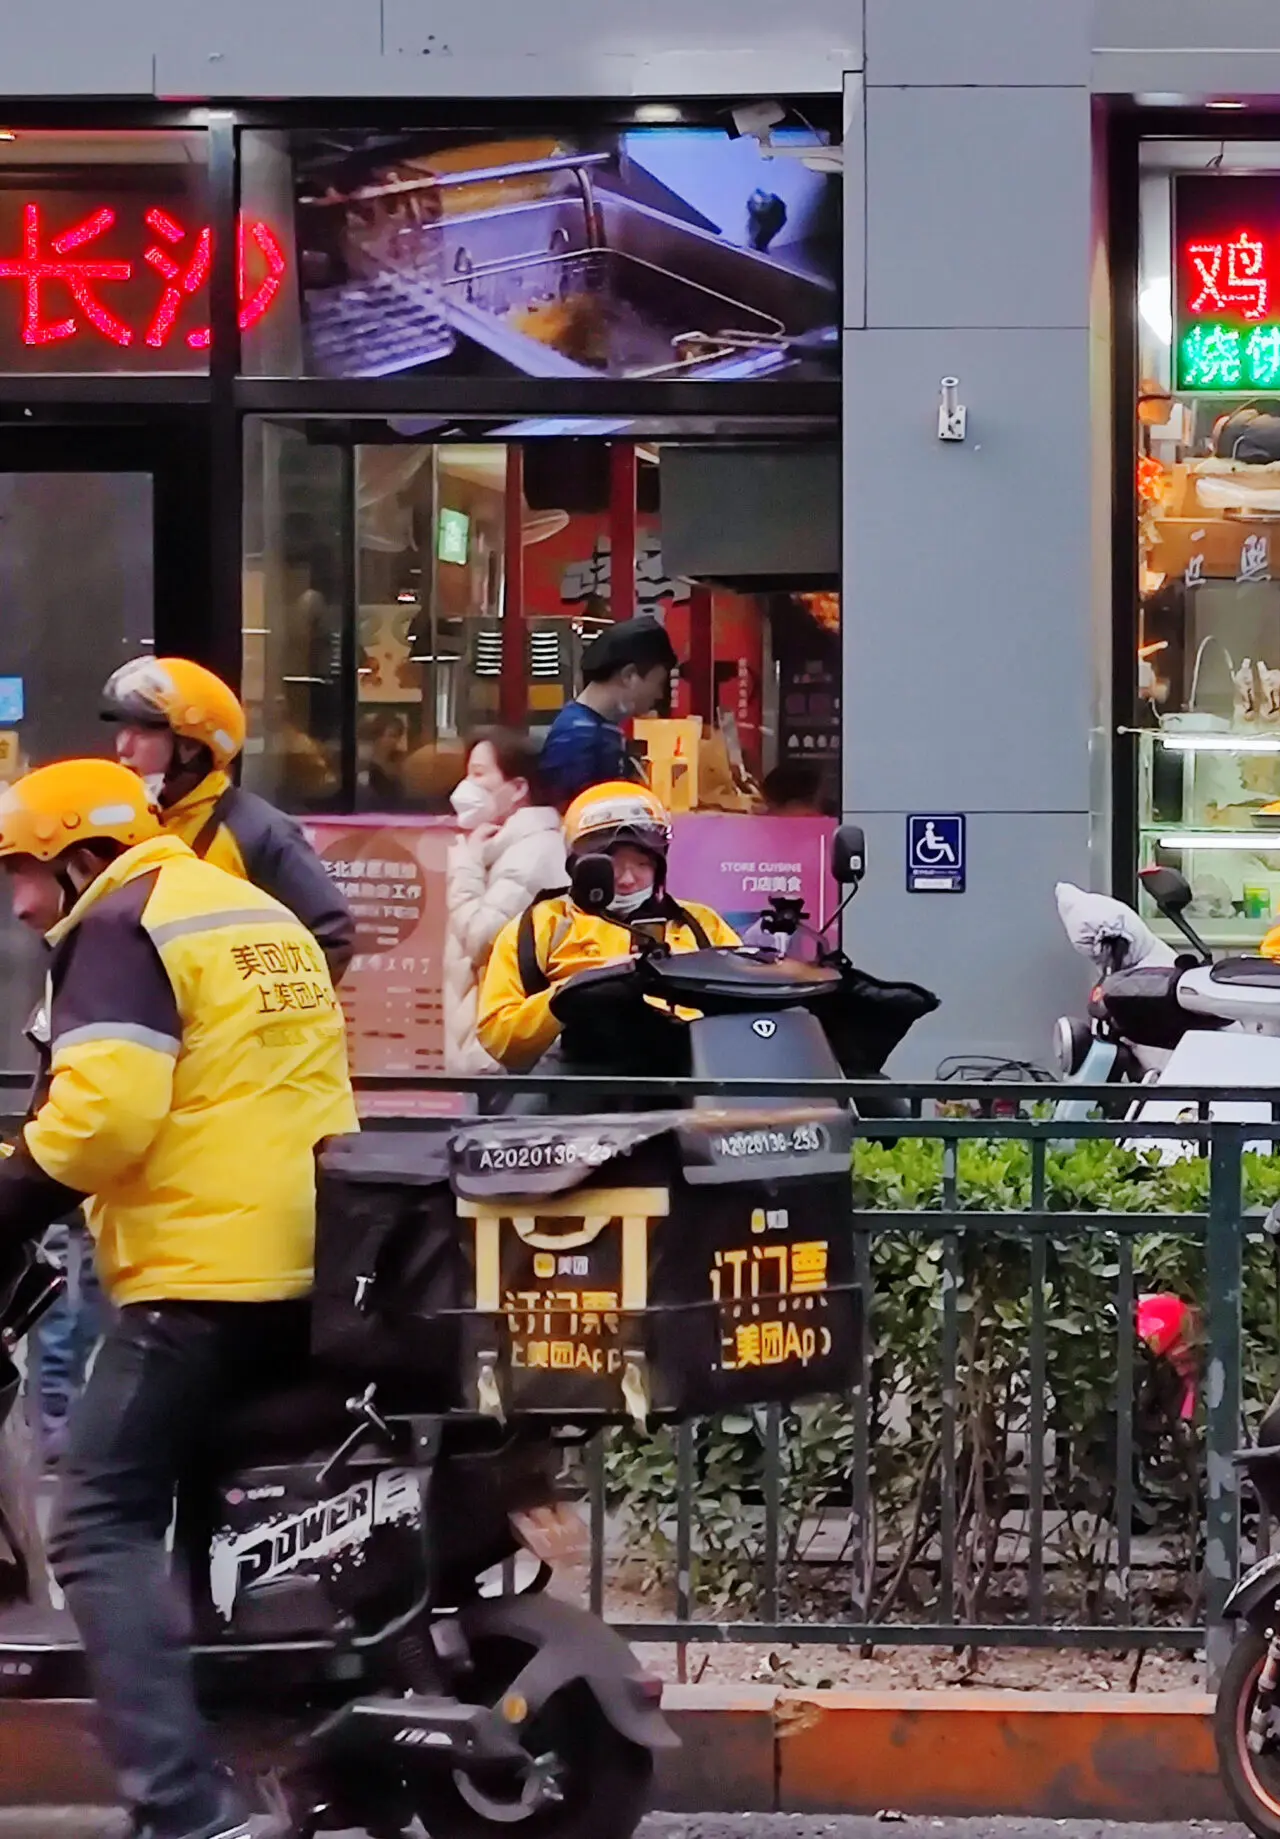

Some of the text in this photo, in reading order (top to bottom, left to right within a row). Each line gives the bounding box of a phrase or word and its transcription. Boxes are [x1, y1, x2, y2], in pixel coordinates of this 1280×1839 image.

[0, 204, 286, 348] 长沙
[720, 862, 756, 873] STORE
[480, 1143, 618, 1169] A2020136-25
[708, 1240, 829, 1318] 订门票
[502, 1290, 620, 1335] 订门票
[236, 1484, 373, 1590] POWER
